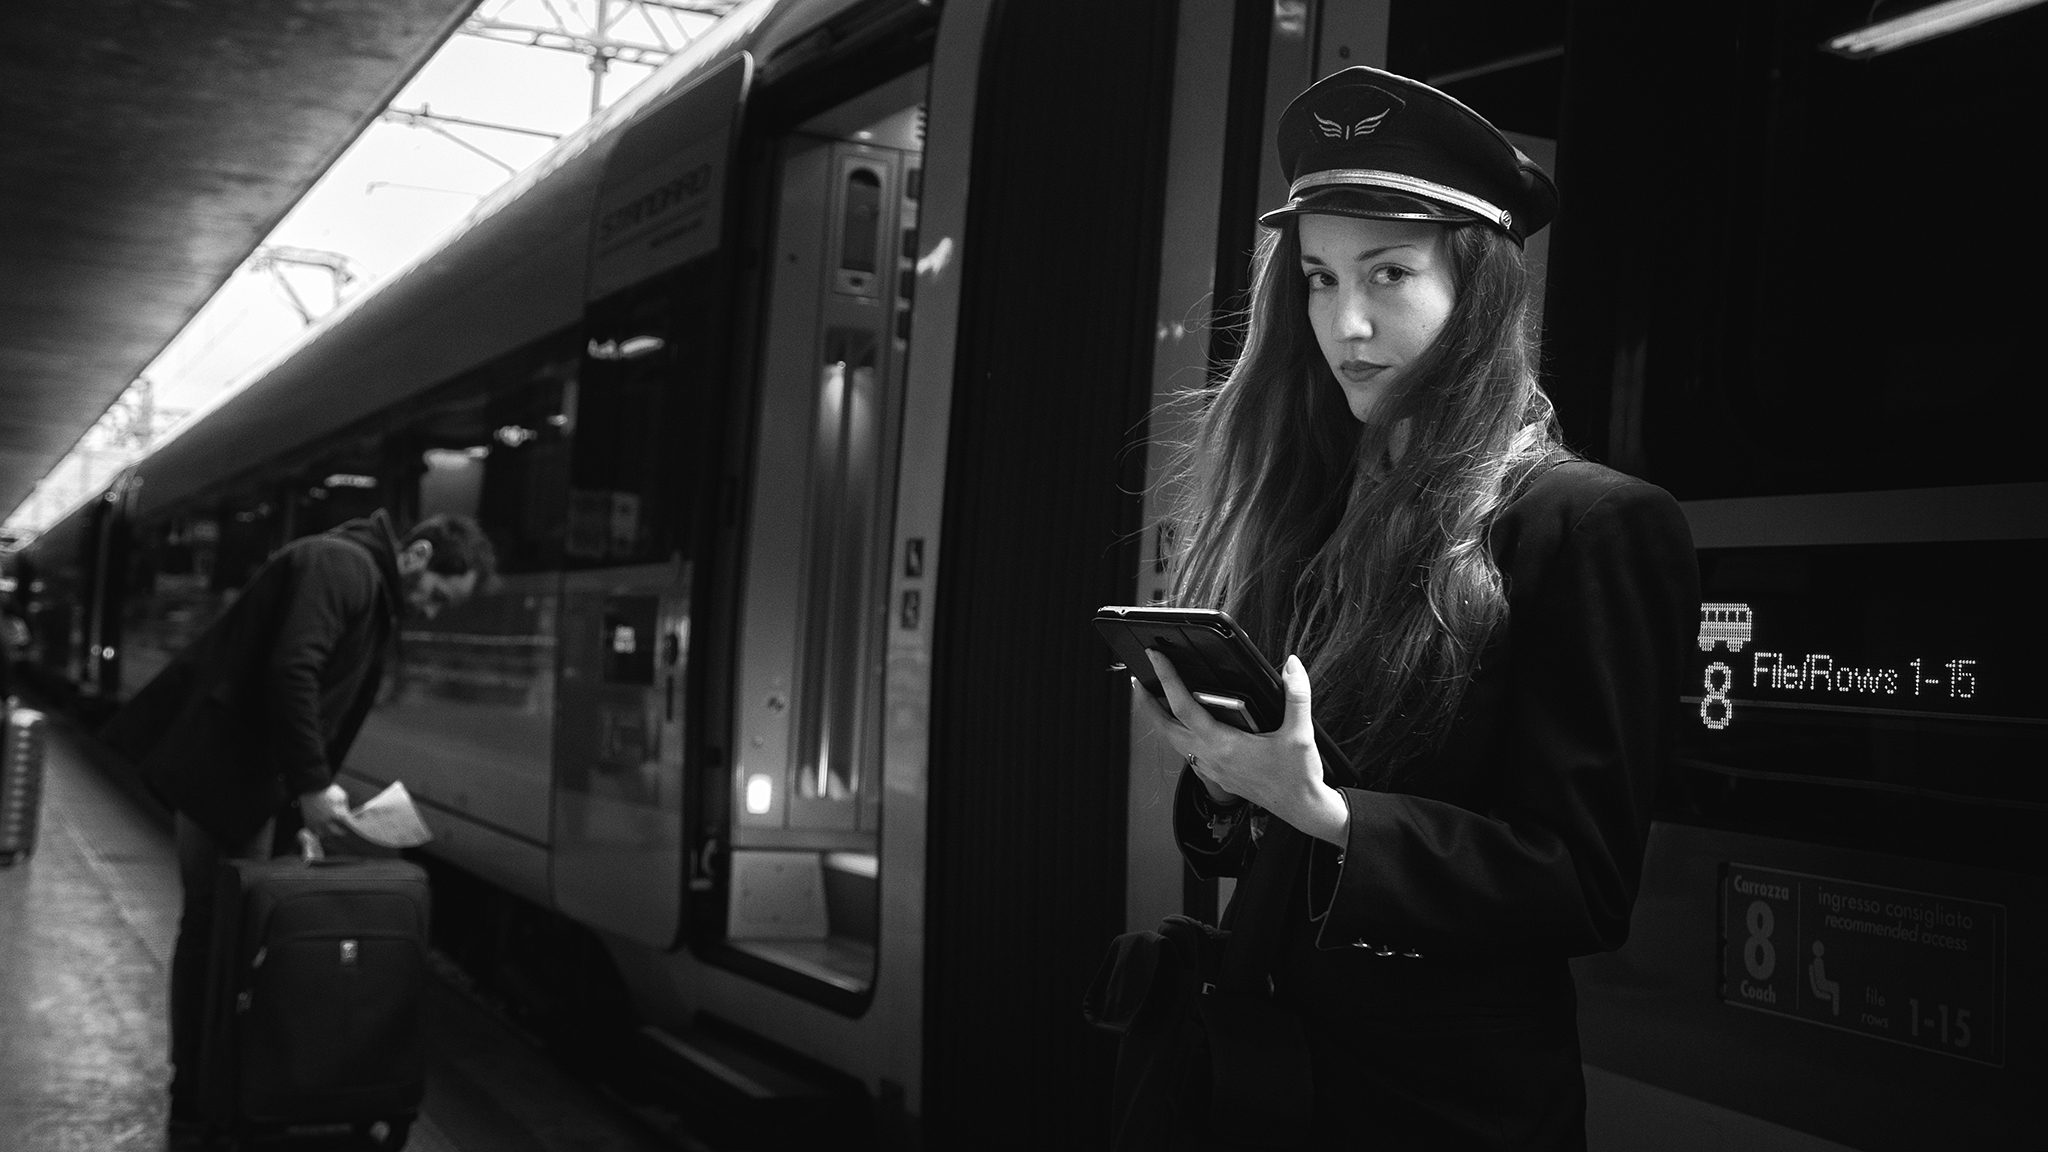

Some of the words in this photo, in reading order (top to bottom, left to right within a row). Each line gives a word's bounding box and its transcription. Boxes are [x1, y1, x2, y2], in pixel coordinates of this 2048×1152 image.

[1752, 651, 1898, 694] File/Rows
[1910, 658, 1978, 698] 1-15
[1701, 661, 1733, 730] 8
[1734, 875, 1790, 900] Carrozza
[1818, 886, 1880, 914] ingresso
[1885, 903, 1973, 931] consigliato
[1743, 900, 1776, 981] 8
[1825, 913, 1919, 942] recommended
[1921, 932, 1969, 951] access
[1740, 980, 1777, 1004] Coach
[1866, 986, 1886, 1008] file
[1861, 1012, 1890, 1029] rows
[1909, 998, 1971, 1048] 1-15
